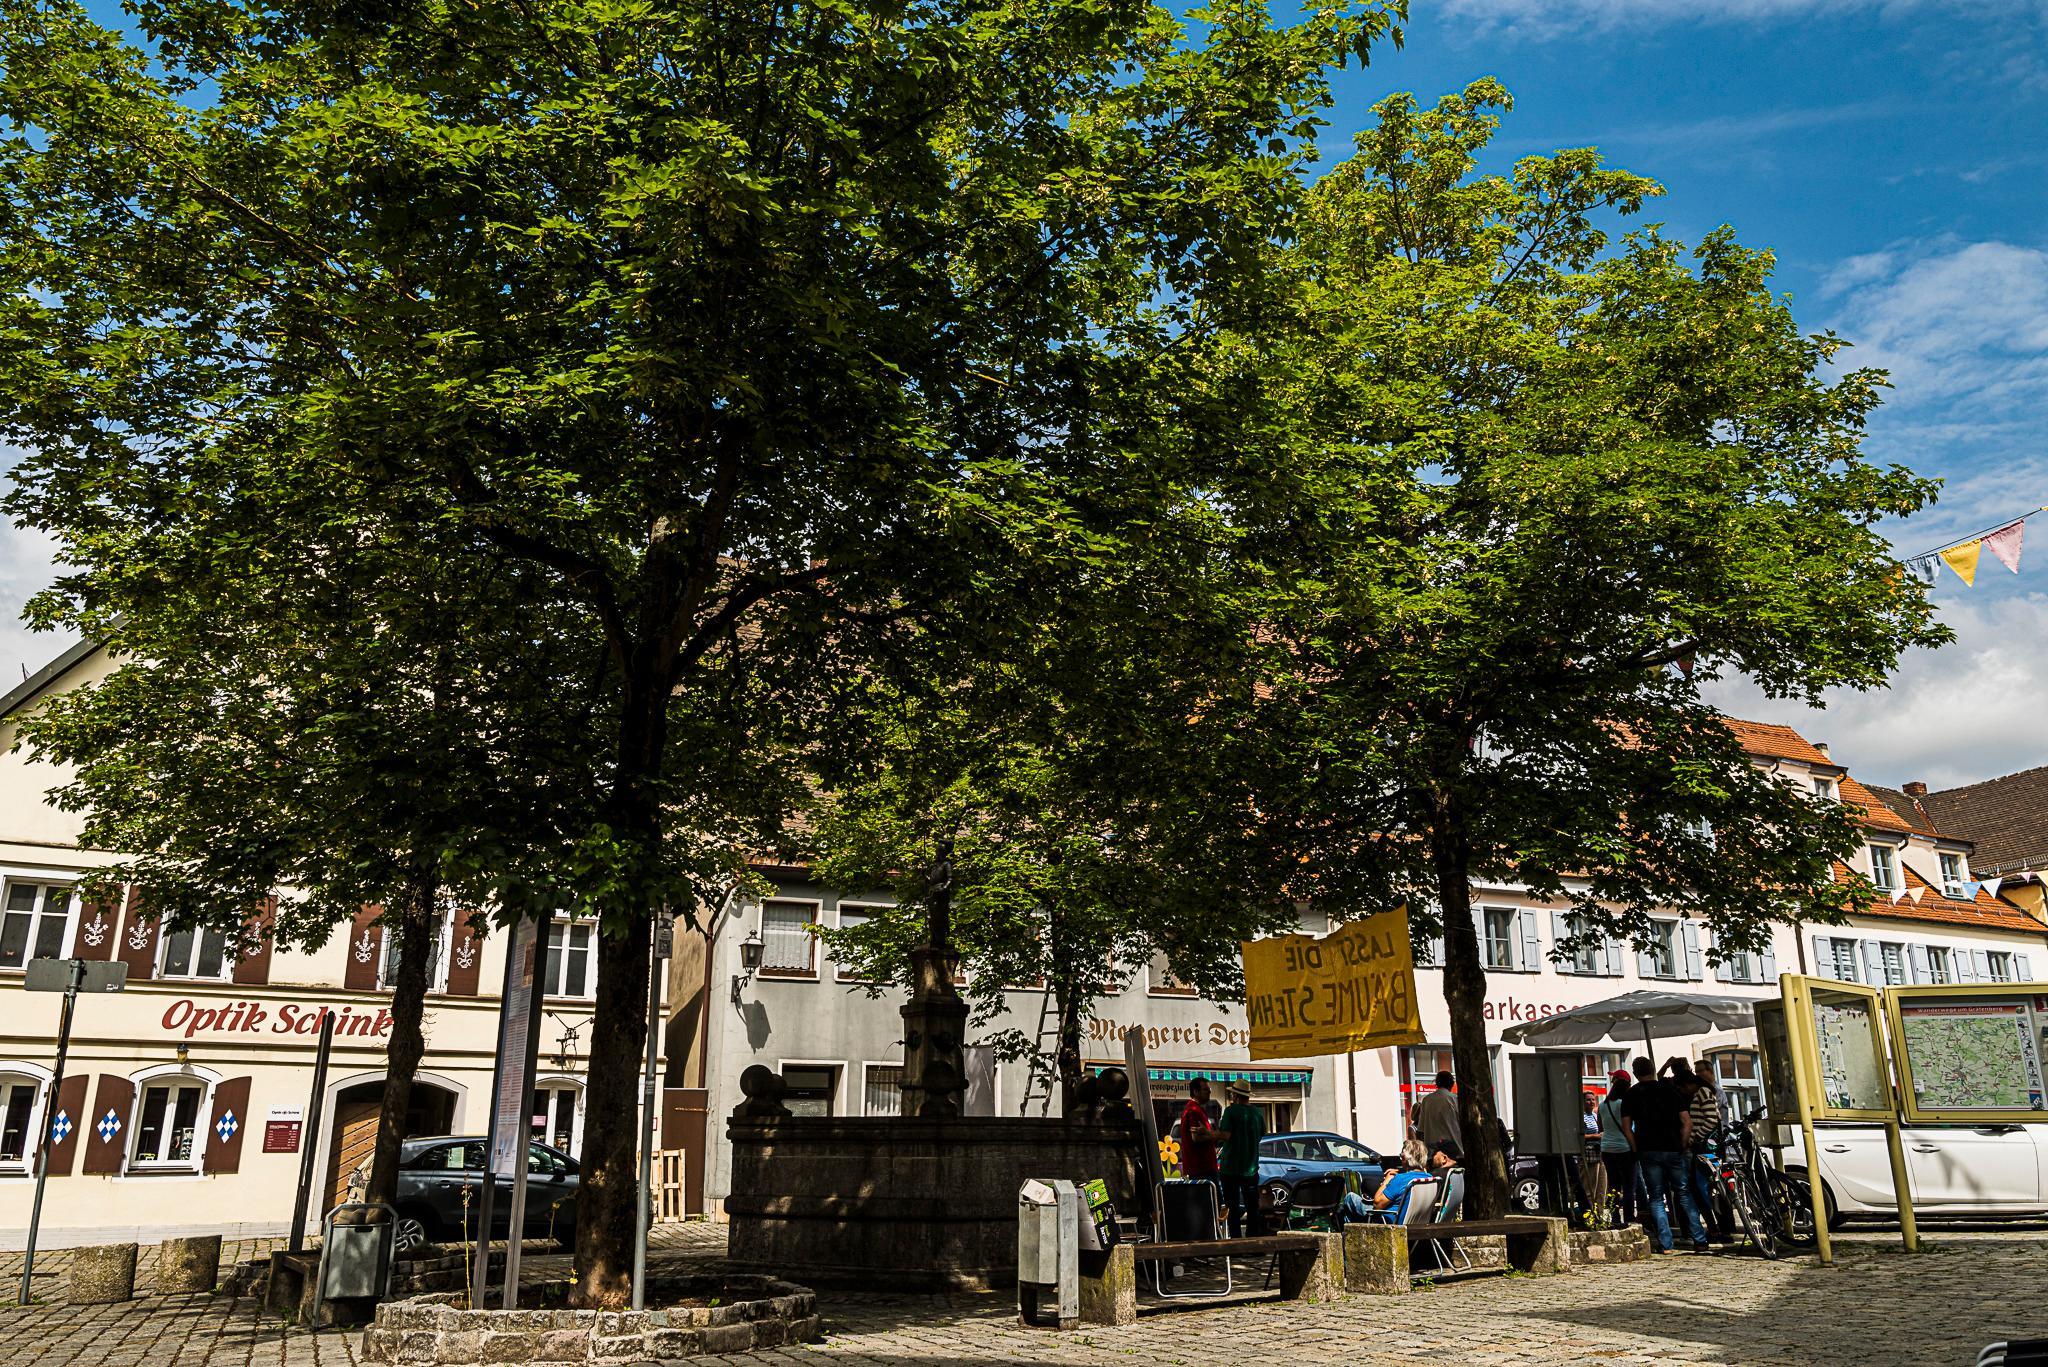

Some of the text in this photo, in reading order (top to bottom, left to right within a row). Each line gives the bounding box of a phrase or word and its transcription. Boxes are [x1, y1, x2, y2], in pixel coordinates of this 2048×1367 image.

[161, 999, 394, 1038] Optik Schink
[1448, 997, 1580, 1021] arkass
[1088, 1018, 1201, 1049] Mezgerei
